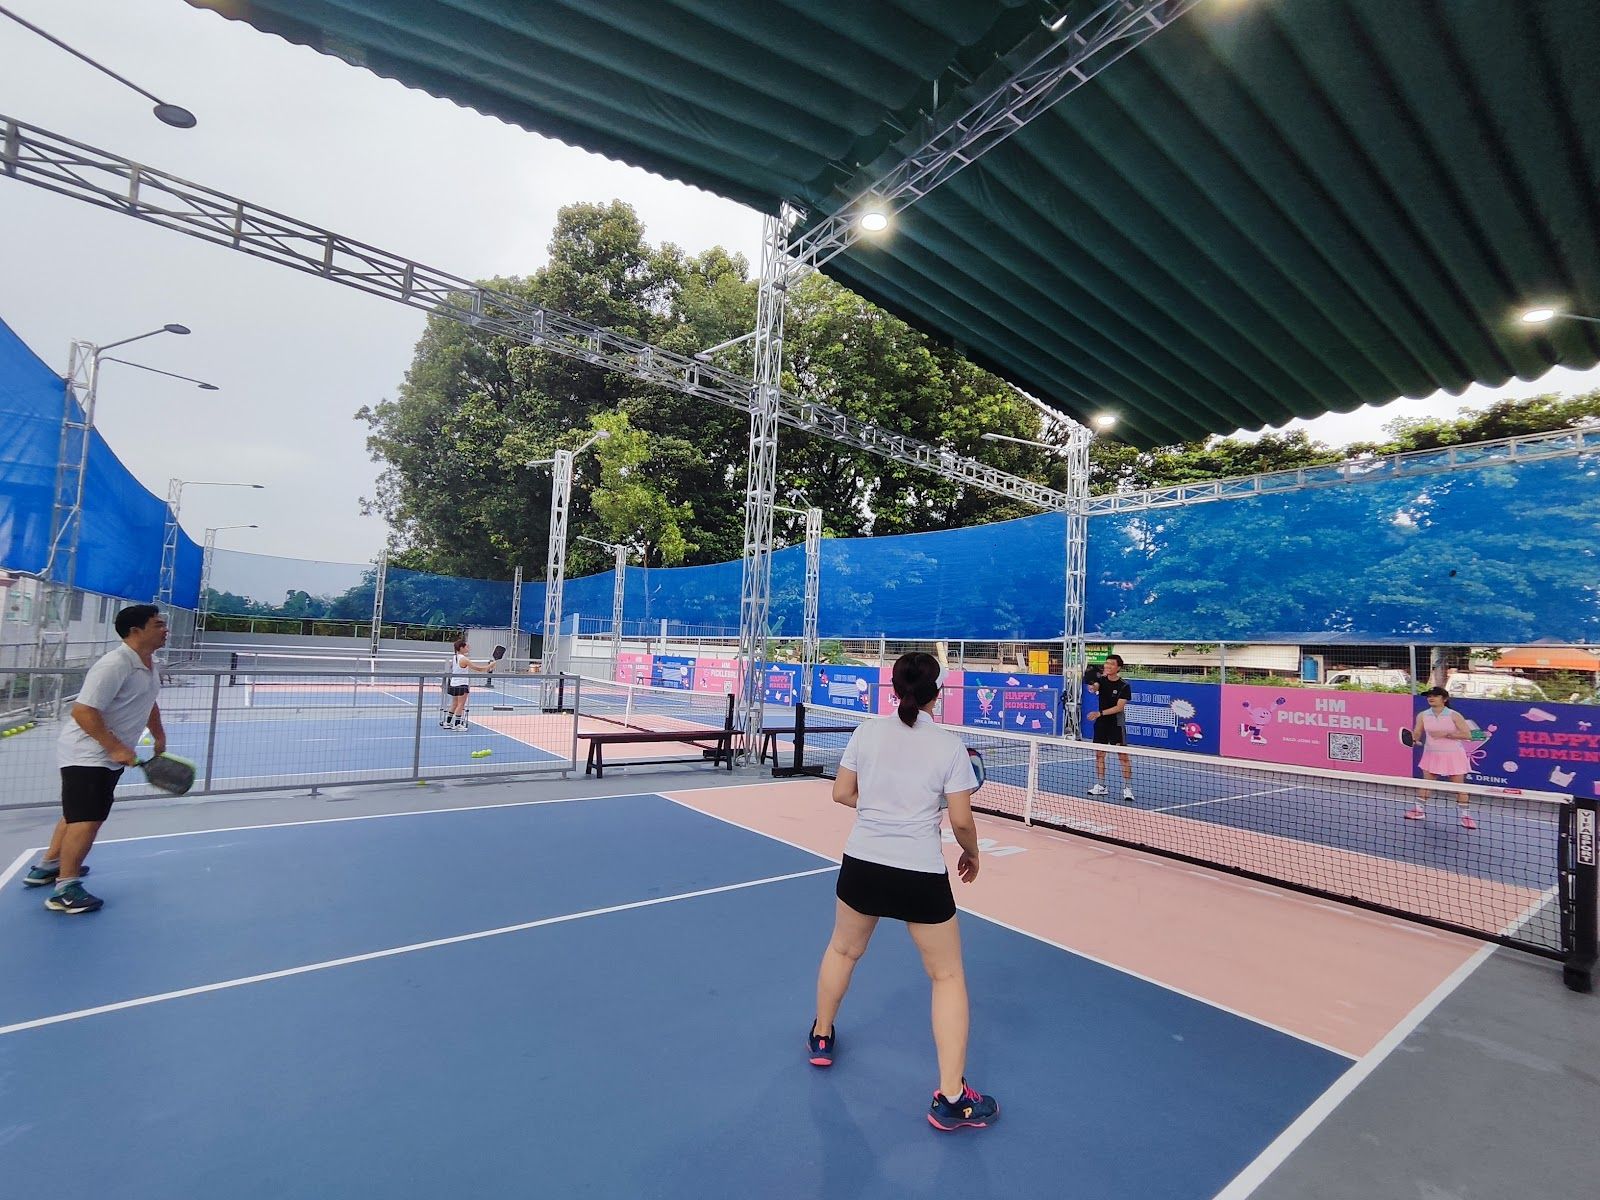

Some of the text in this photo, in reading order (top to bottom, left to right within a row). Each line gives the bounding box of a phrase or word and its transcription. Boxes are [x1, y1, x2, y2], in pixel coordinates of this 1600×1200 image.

[1005, 691, 1036, 700] HAPPY
[1005, 702, 1046, 710] MOMENTS
[1315, 698, 1346, 713] HM
[1277, 710, 1389, 732] PICKLEBALL
[1153, 728, 1168, 738] WIN
[1519, 732, 1600, 748] HAPPY
[1519, 748, 1600, 762] MOMEN
[1476, 775, 1508, 784] DRINK
